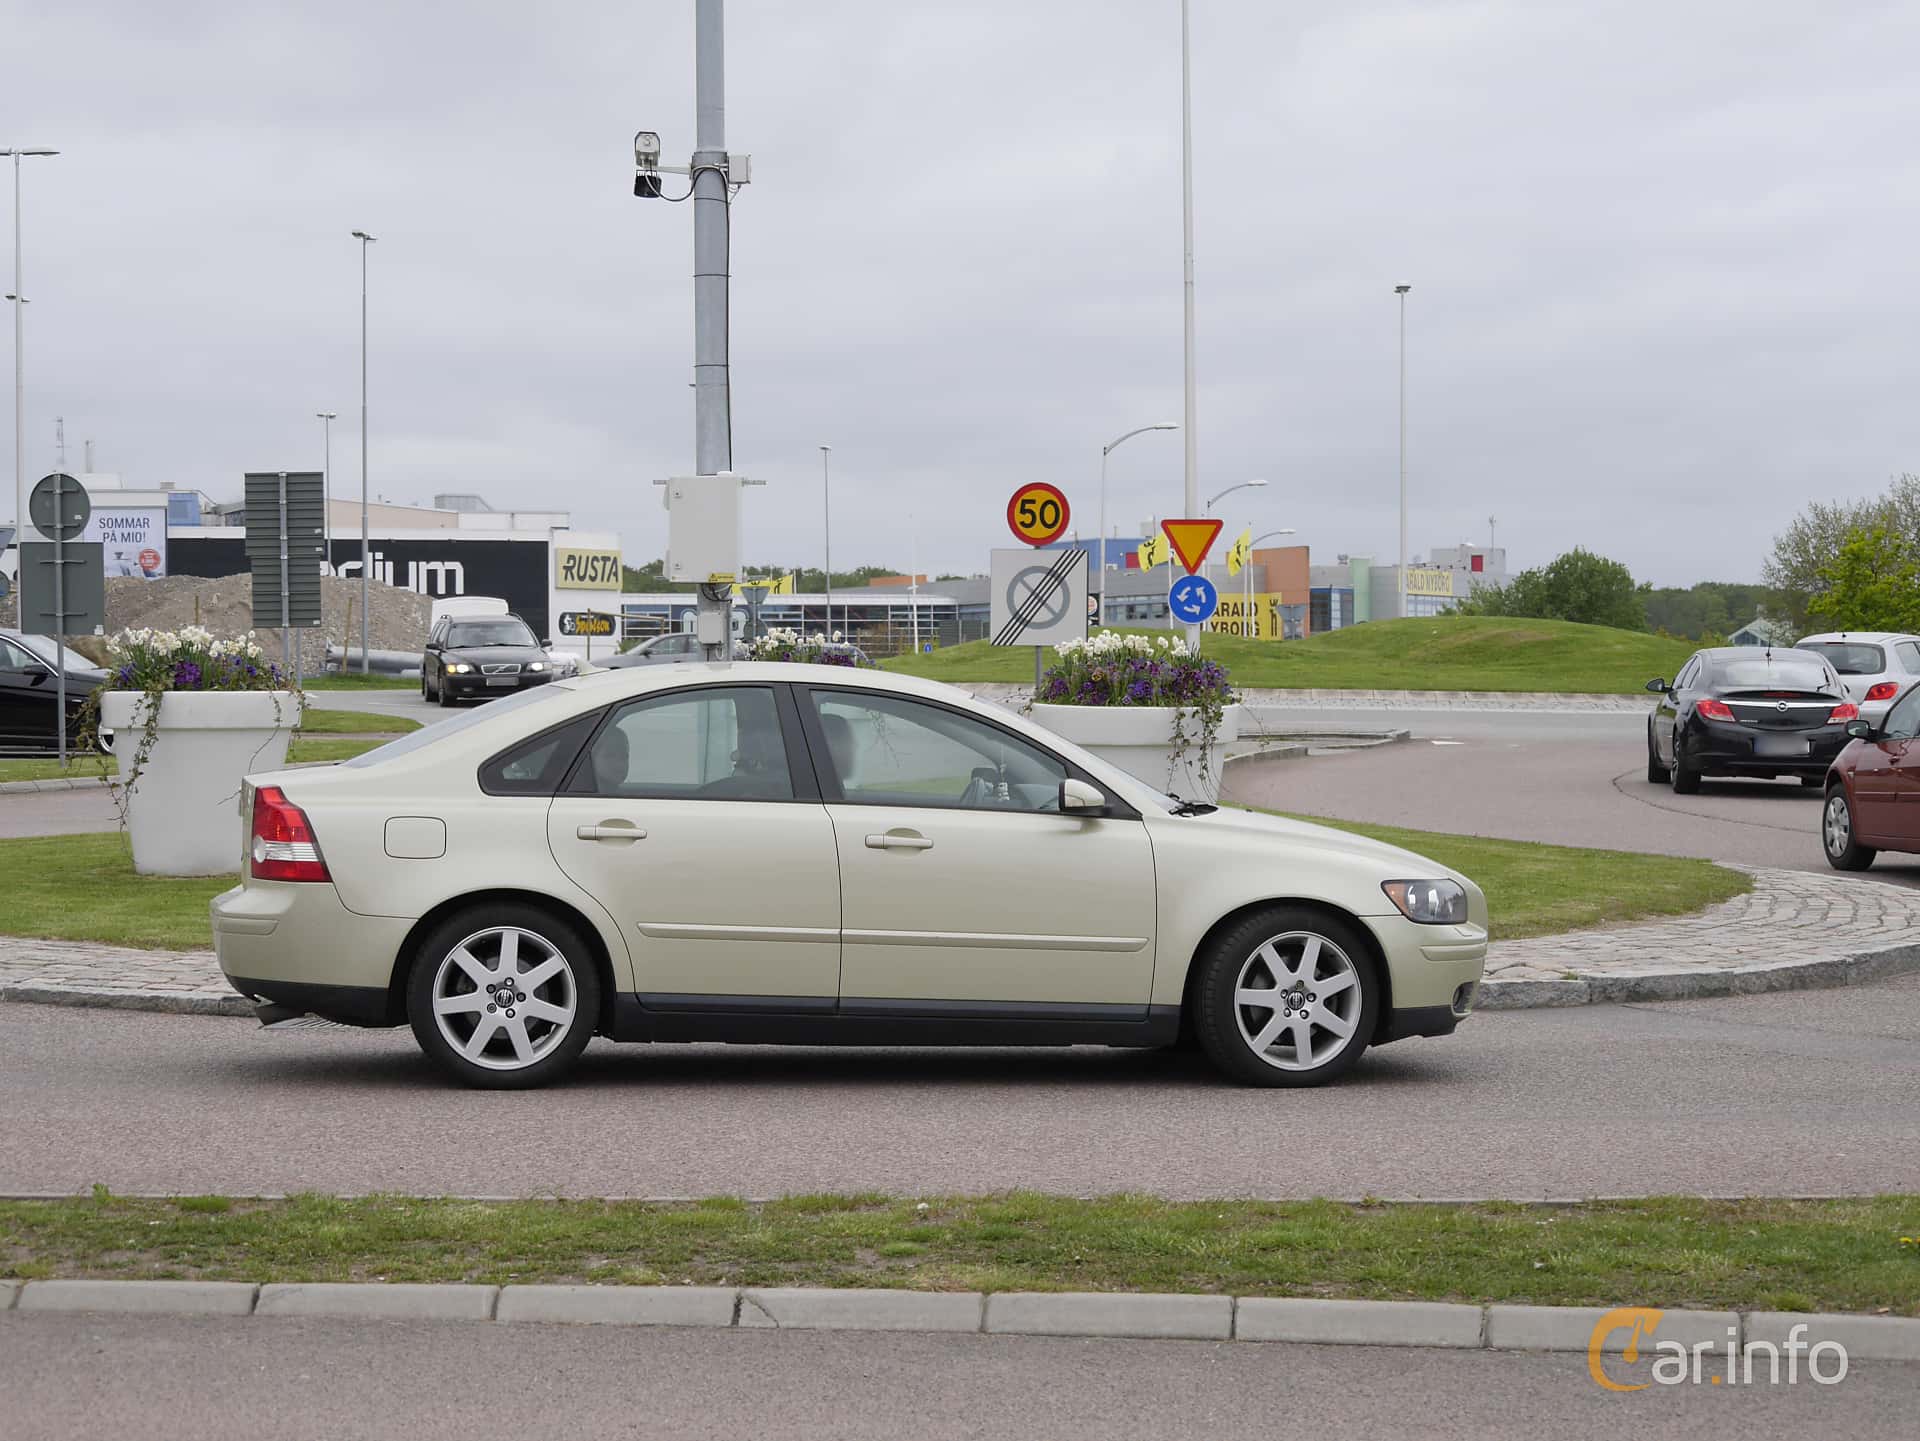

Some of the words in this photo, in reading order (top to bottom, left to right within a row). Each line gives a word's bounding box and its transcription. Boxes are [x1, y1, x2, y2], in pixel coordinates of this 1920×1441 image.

[98, 517, 151, 529] SOMMAR
[1018, 498, 1061, 529] 50
[102, 529, 117, 543] PÅ
[120, 531, 146, 543] MIO!
[319, 552, 465, 595] dium
[562, 554, 619, 583] RUSTA
[1200, 621, 1260, 637] YBORG
